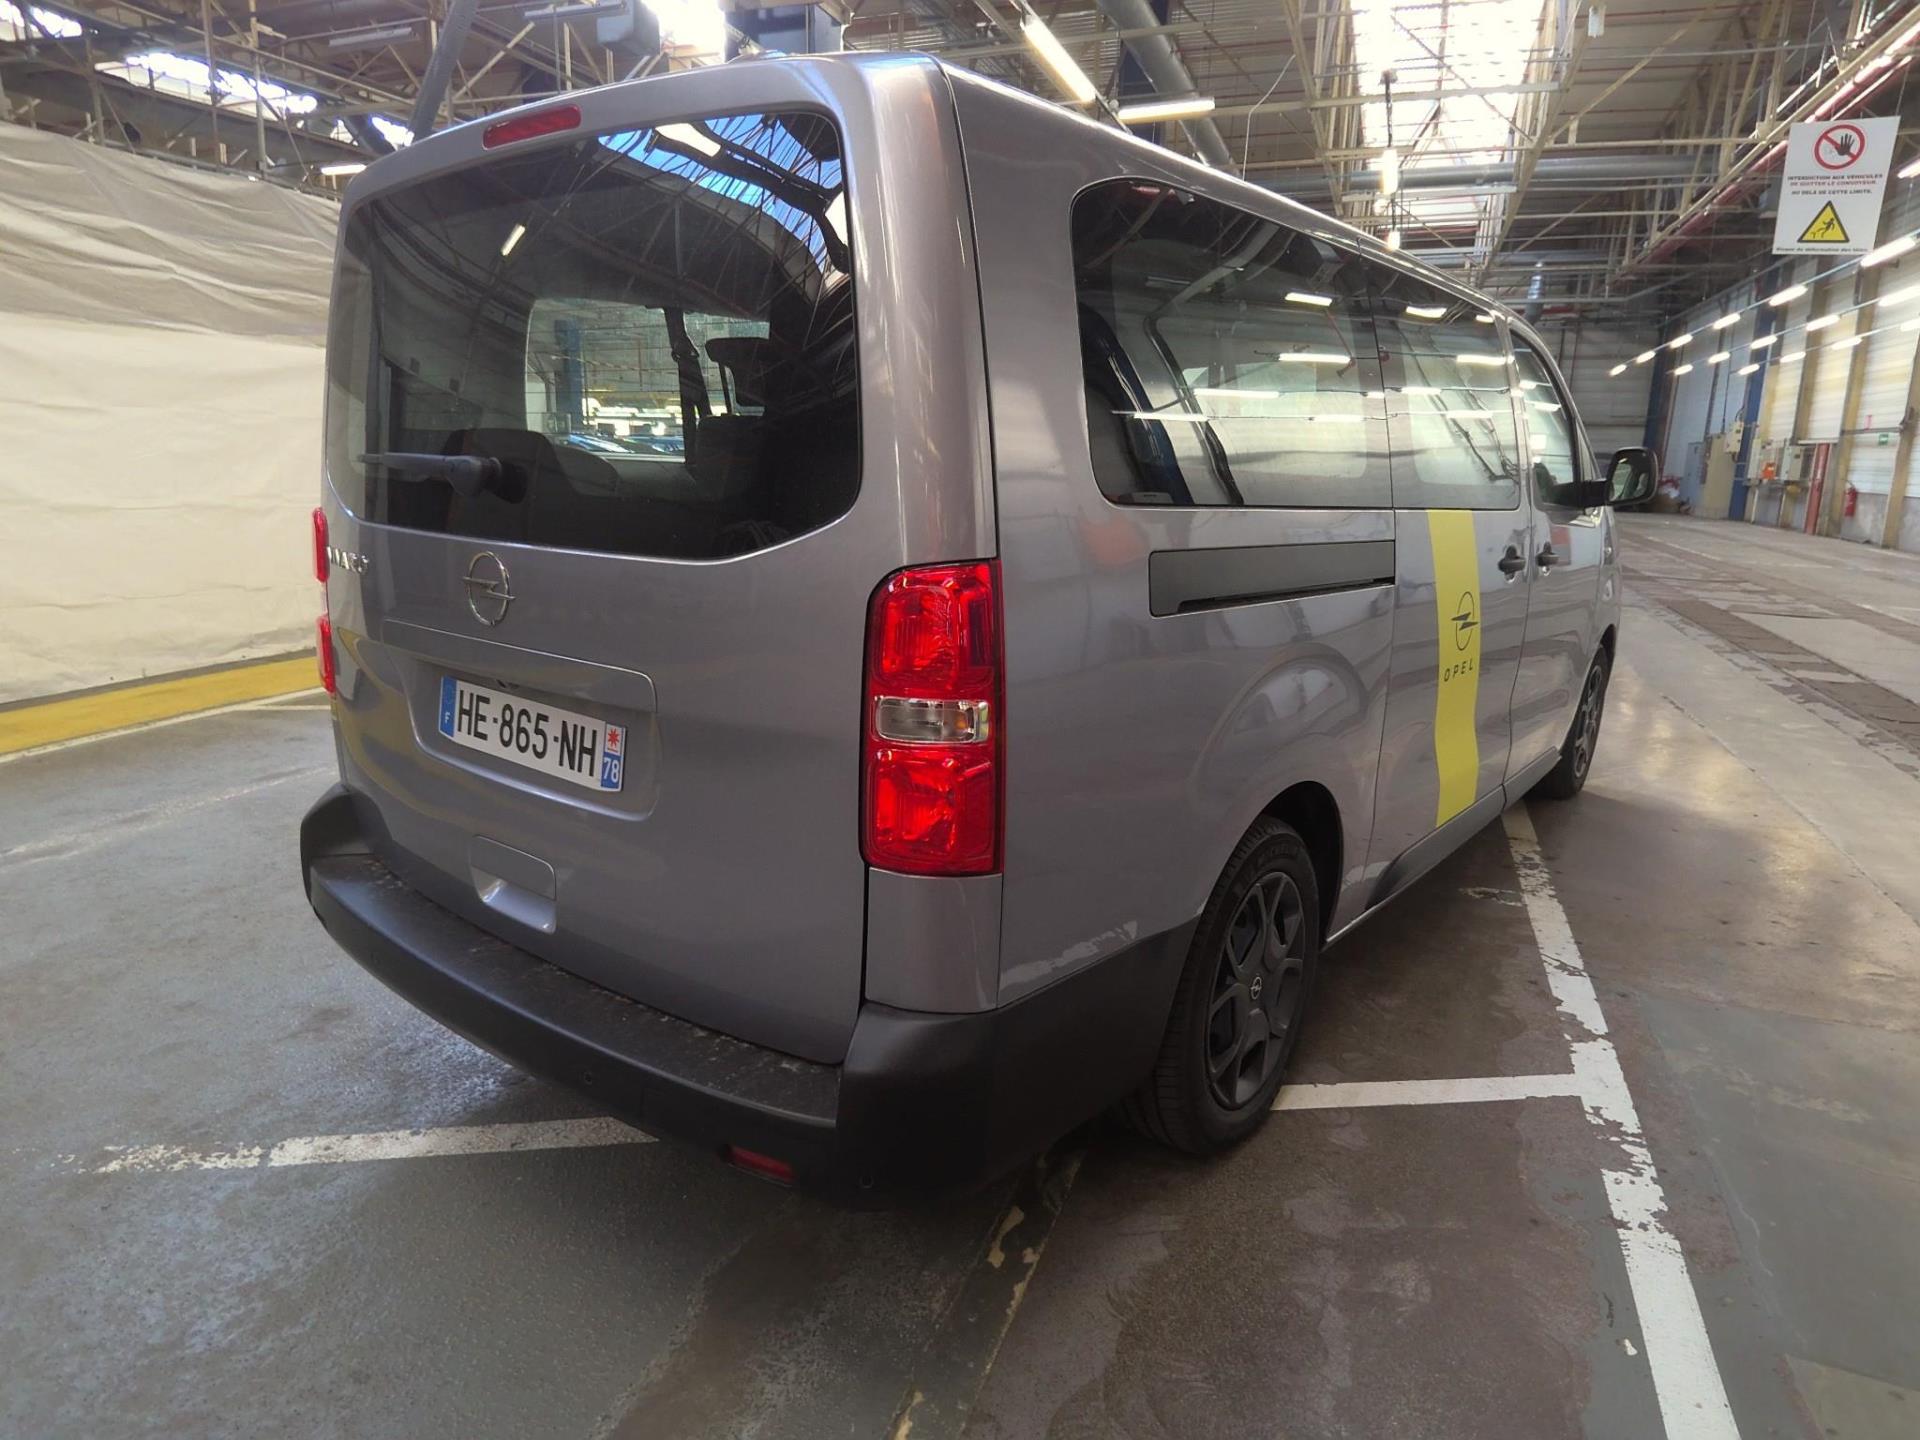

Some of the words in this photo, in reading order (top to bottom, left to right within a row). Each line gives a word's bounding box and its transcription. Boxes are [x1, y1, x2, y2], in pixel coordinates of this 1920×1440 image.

[1443, 658, 1473, 682] OPEL
[444, 711, 451, 724] F
[457, 690, 598, 777] HE-865-NH
[603, 756, 620, 783] 78
